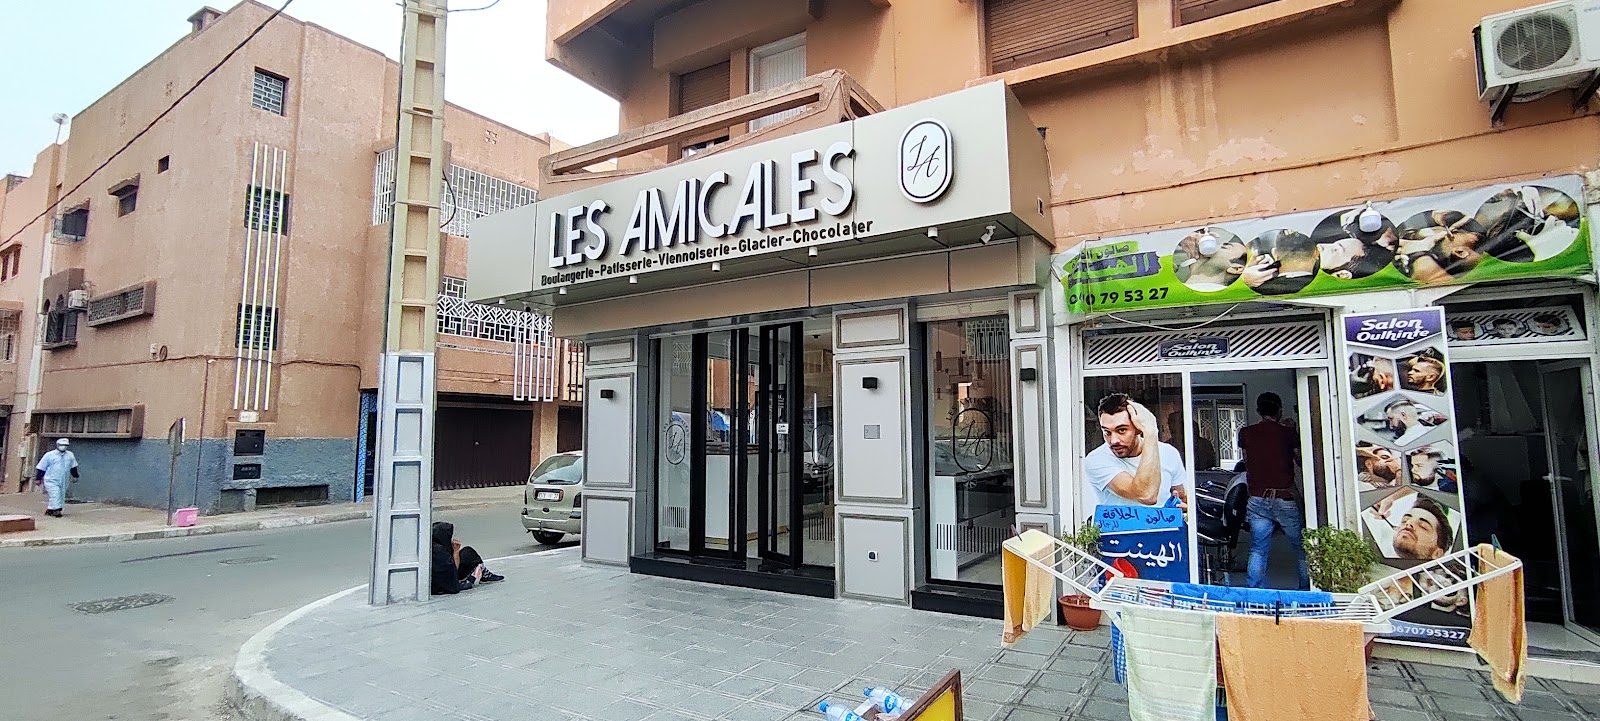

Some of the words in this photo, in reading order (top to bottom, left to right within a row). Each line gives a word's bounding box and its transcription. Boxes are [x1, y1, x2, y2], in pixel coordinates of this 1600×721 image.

[549, 199, 610, 269] LES
[619, 141, 855, 256] AMICALES
[1100, 292, 1119, 304] 79
[1124, 290, 1143, 302] 53
[1149, 287, 1169, 300] 27
[1361, 318, 1424, 331] Salon
[1172, 343, 1218, 351] Salon
[1145, 509, 1176, 524] صالون
[1097, 541, 1182, 567] الهينت
